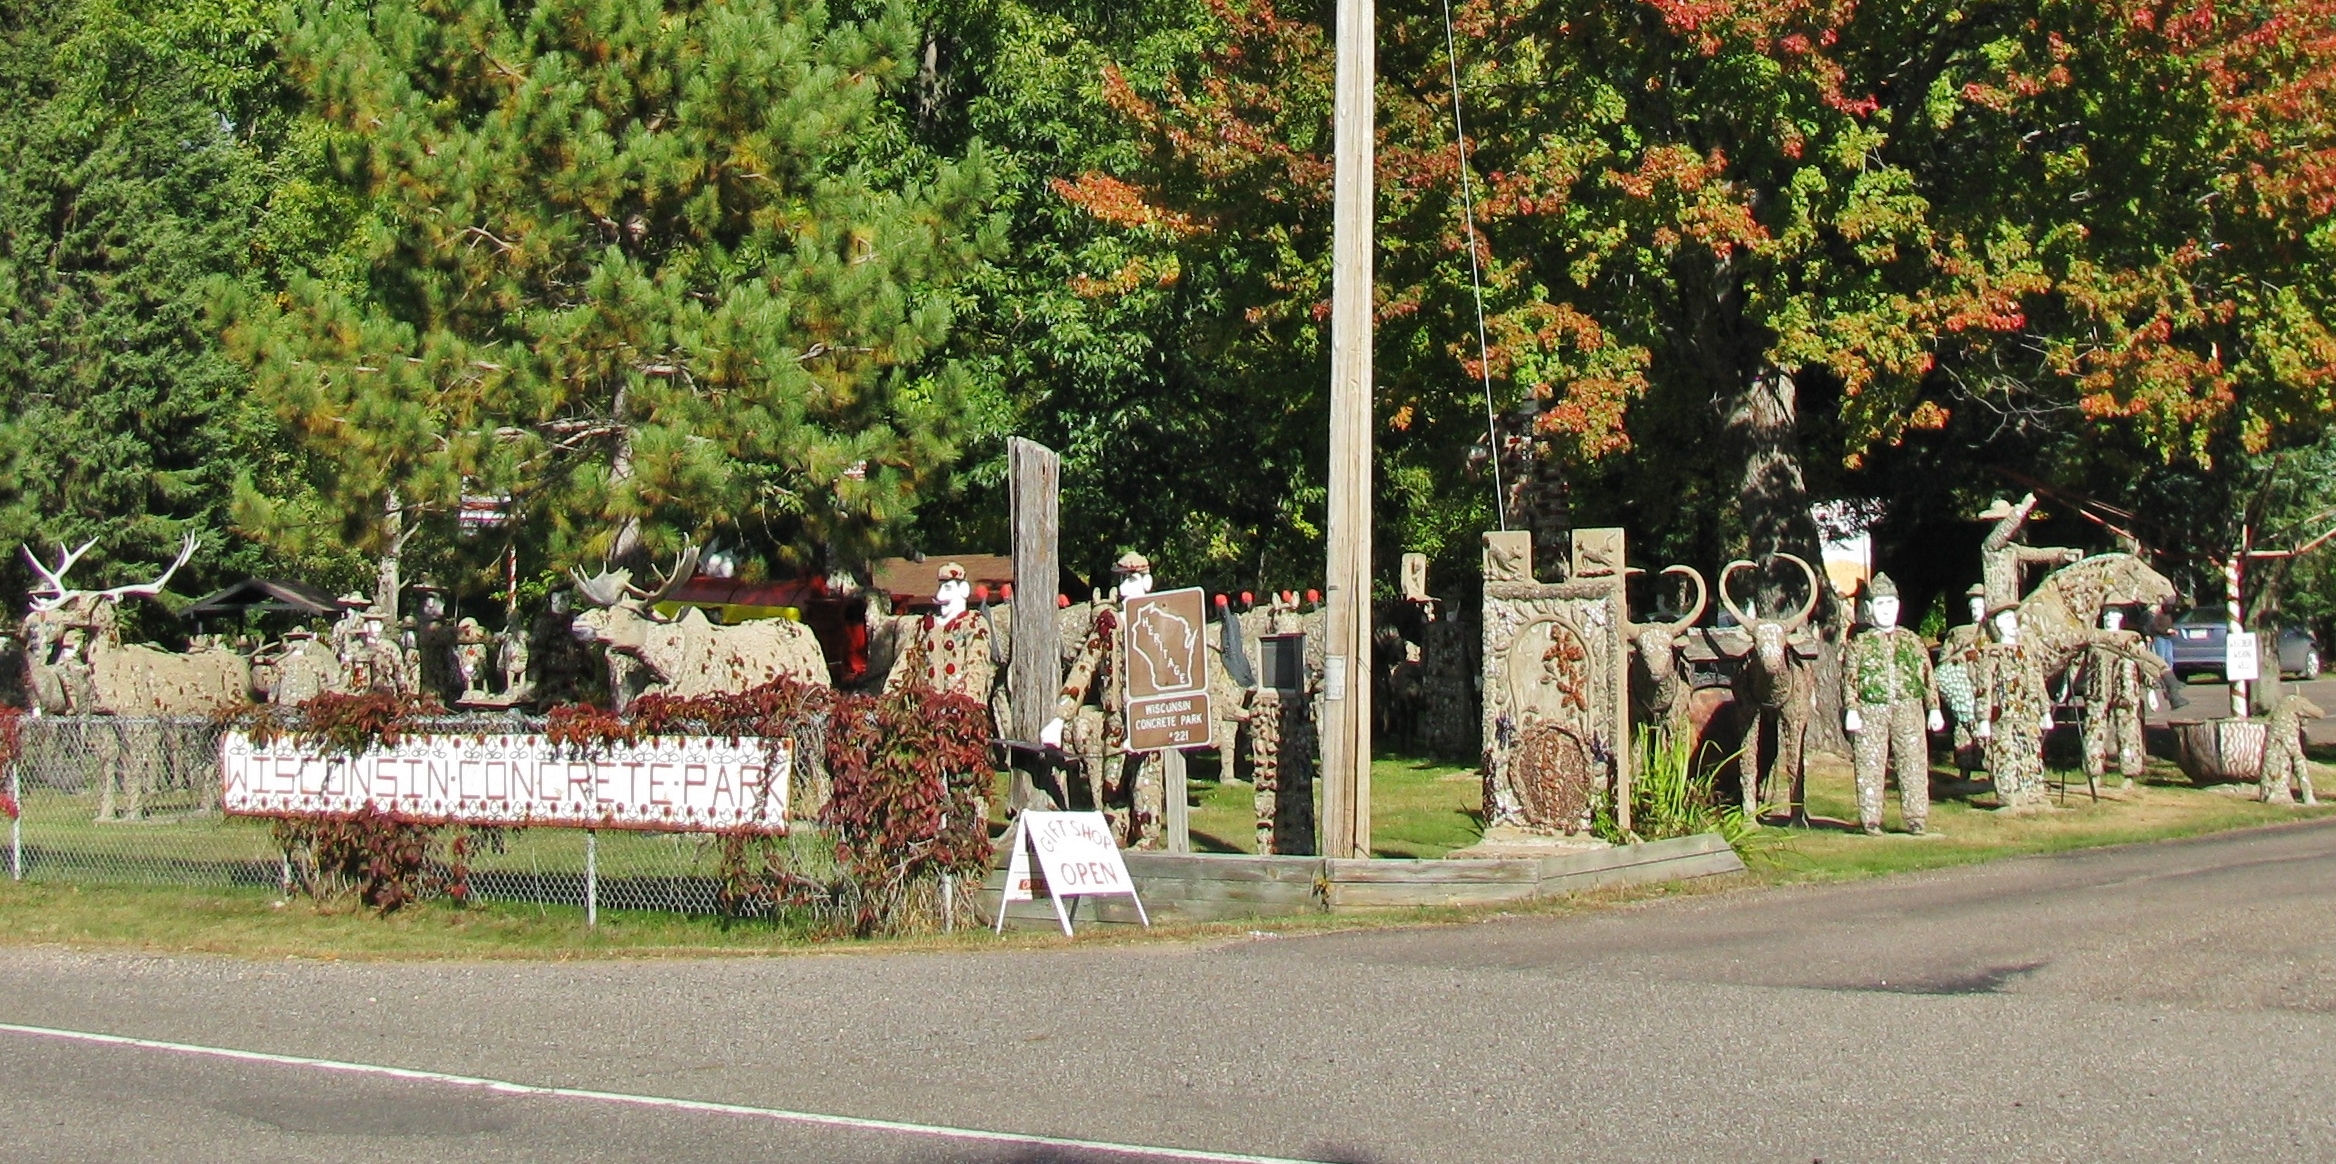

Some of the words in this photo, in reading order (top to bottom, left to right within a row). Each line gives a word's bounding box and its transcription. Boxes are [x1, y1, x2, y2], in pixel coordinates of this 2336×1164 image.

[1142, 617, 1185, 684] HERITAGE
[1145, 700, 1191, 715] WISCONSIN
[1135, 716, 1176, 731] CONCRETE
[1180, 713, 1203, 727] PARK
[1040, 820, 1067, 853] GIFT
[1070, 820, 1112, 850] SHOP
[1061, 862, 1119, 885] OPEN
